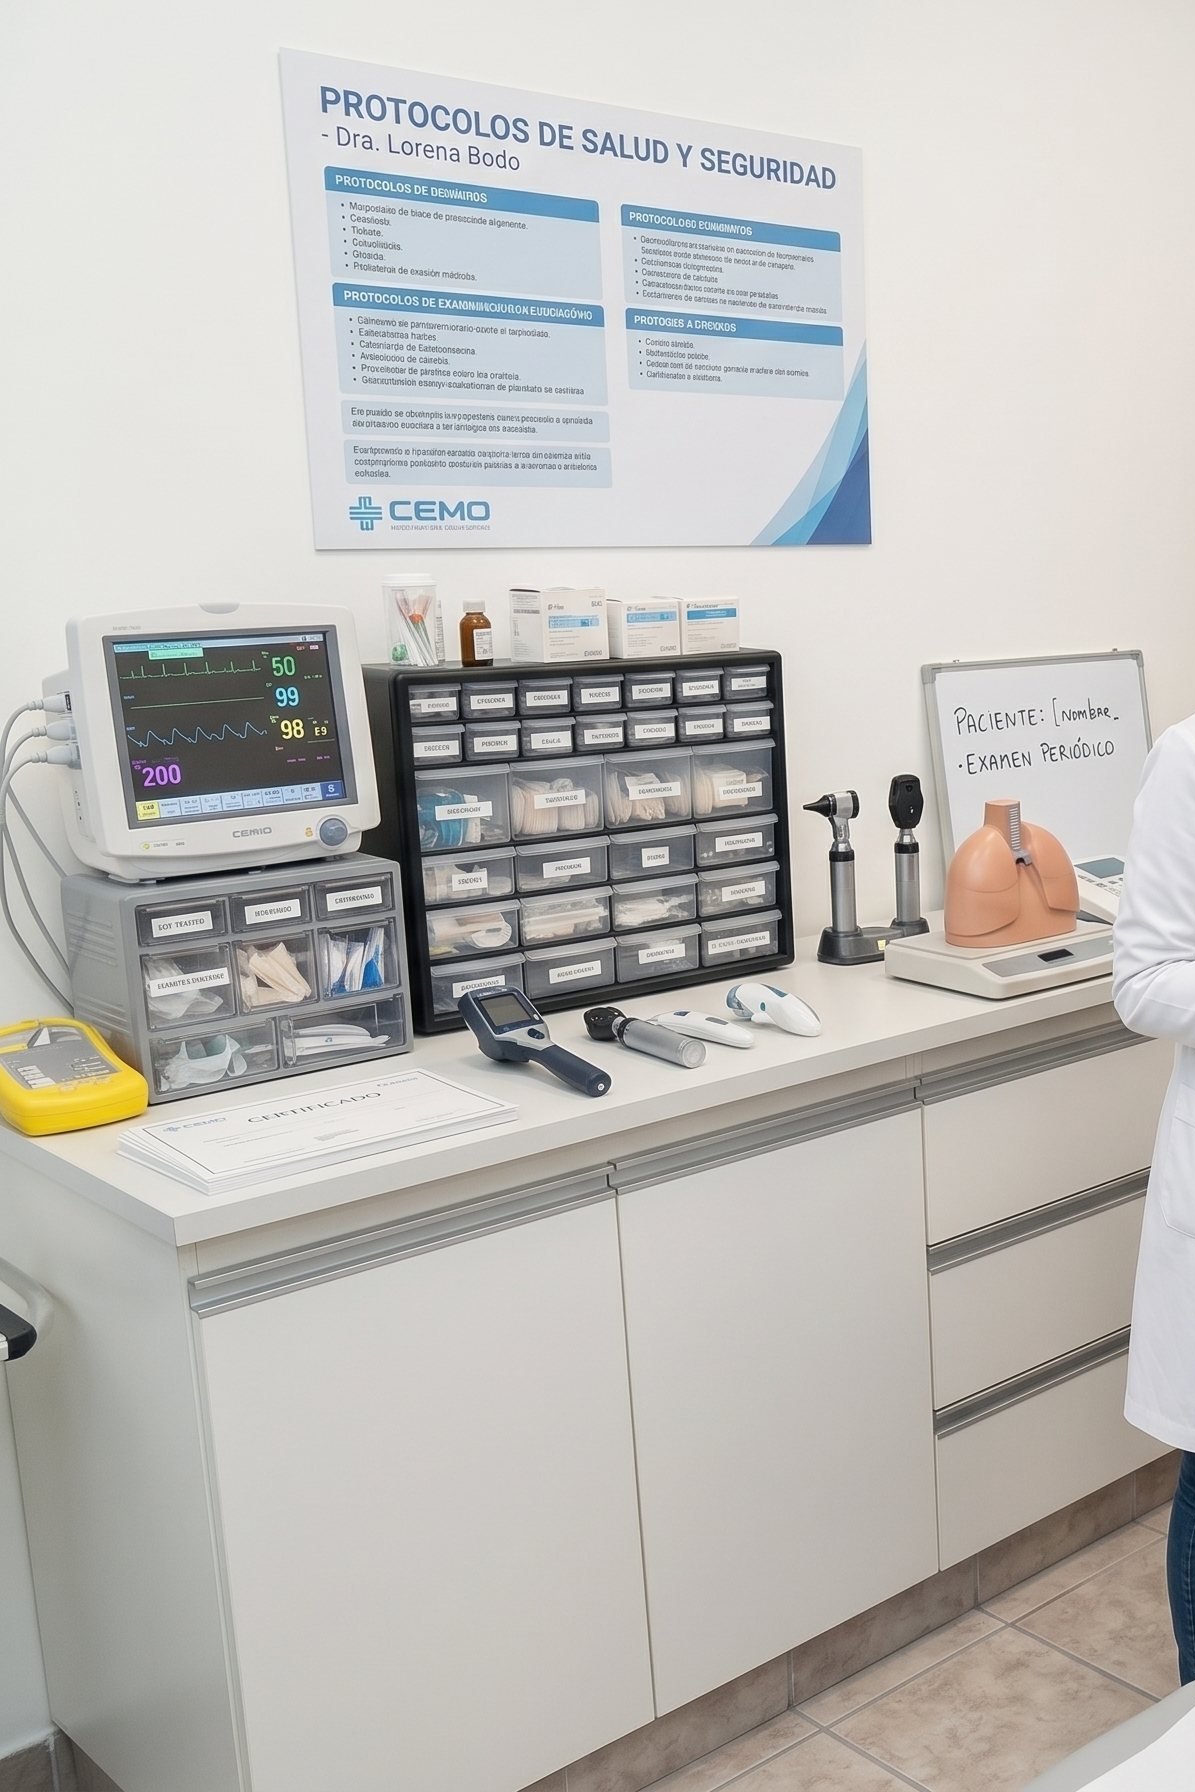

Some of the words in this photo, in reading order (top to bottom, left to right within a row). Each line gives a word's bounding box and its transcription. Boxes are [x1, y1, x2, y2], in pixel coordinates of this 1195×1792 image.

[320, 86, 530, 144] PROTOCOLOS
[538, 121, 574, 151] DE
[582, 128, 669, 165] SALUD
[676, 143, 692, 167] Y
[700, 147, 836, 190] SEGURIDAD
[336, 126, 380, 152] Dra.
[388, 133, 460, 163] Lorena
[468, 146, 520, 171] Bodo
[335, 175, 411, 194] PROTOCOLOS
[414, 185, 428, 196] DE
[433, 211, 443, 220] de
[398, 266, 408, 275] de
[344, 290, 419, 307] PROTOCOLOS
[422, 297, 436, 308] DE
[406, 342, 416, 352] de
[407, 354, 417, 363] de
[389, 501, 490, 521] CEMO
[271, 656, 296, 677] 50
[275, 686, 299, 708] 99
[280, 719, 305, 740] 98
[953, 706, 1044, 734] PACIENTE:
[1040, 736, 1115, 763] PERIÓDICO
[142, 764, 182, 787] 200
